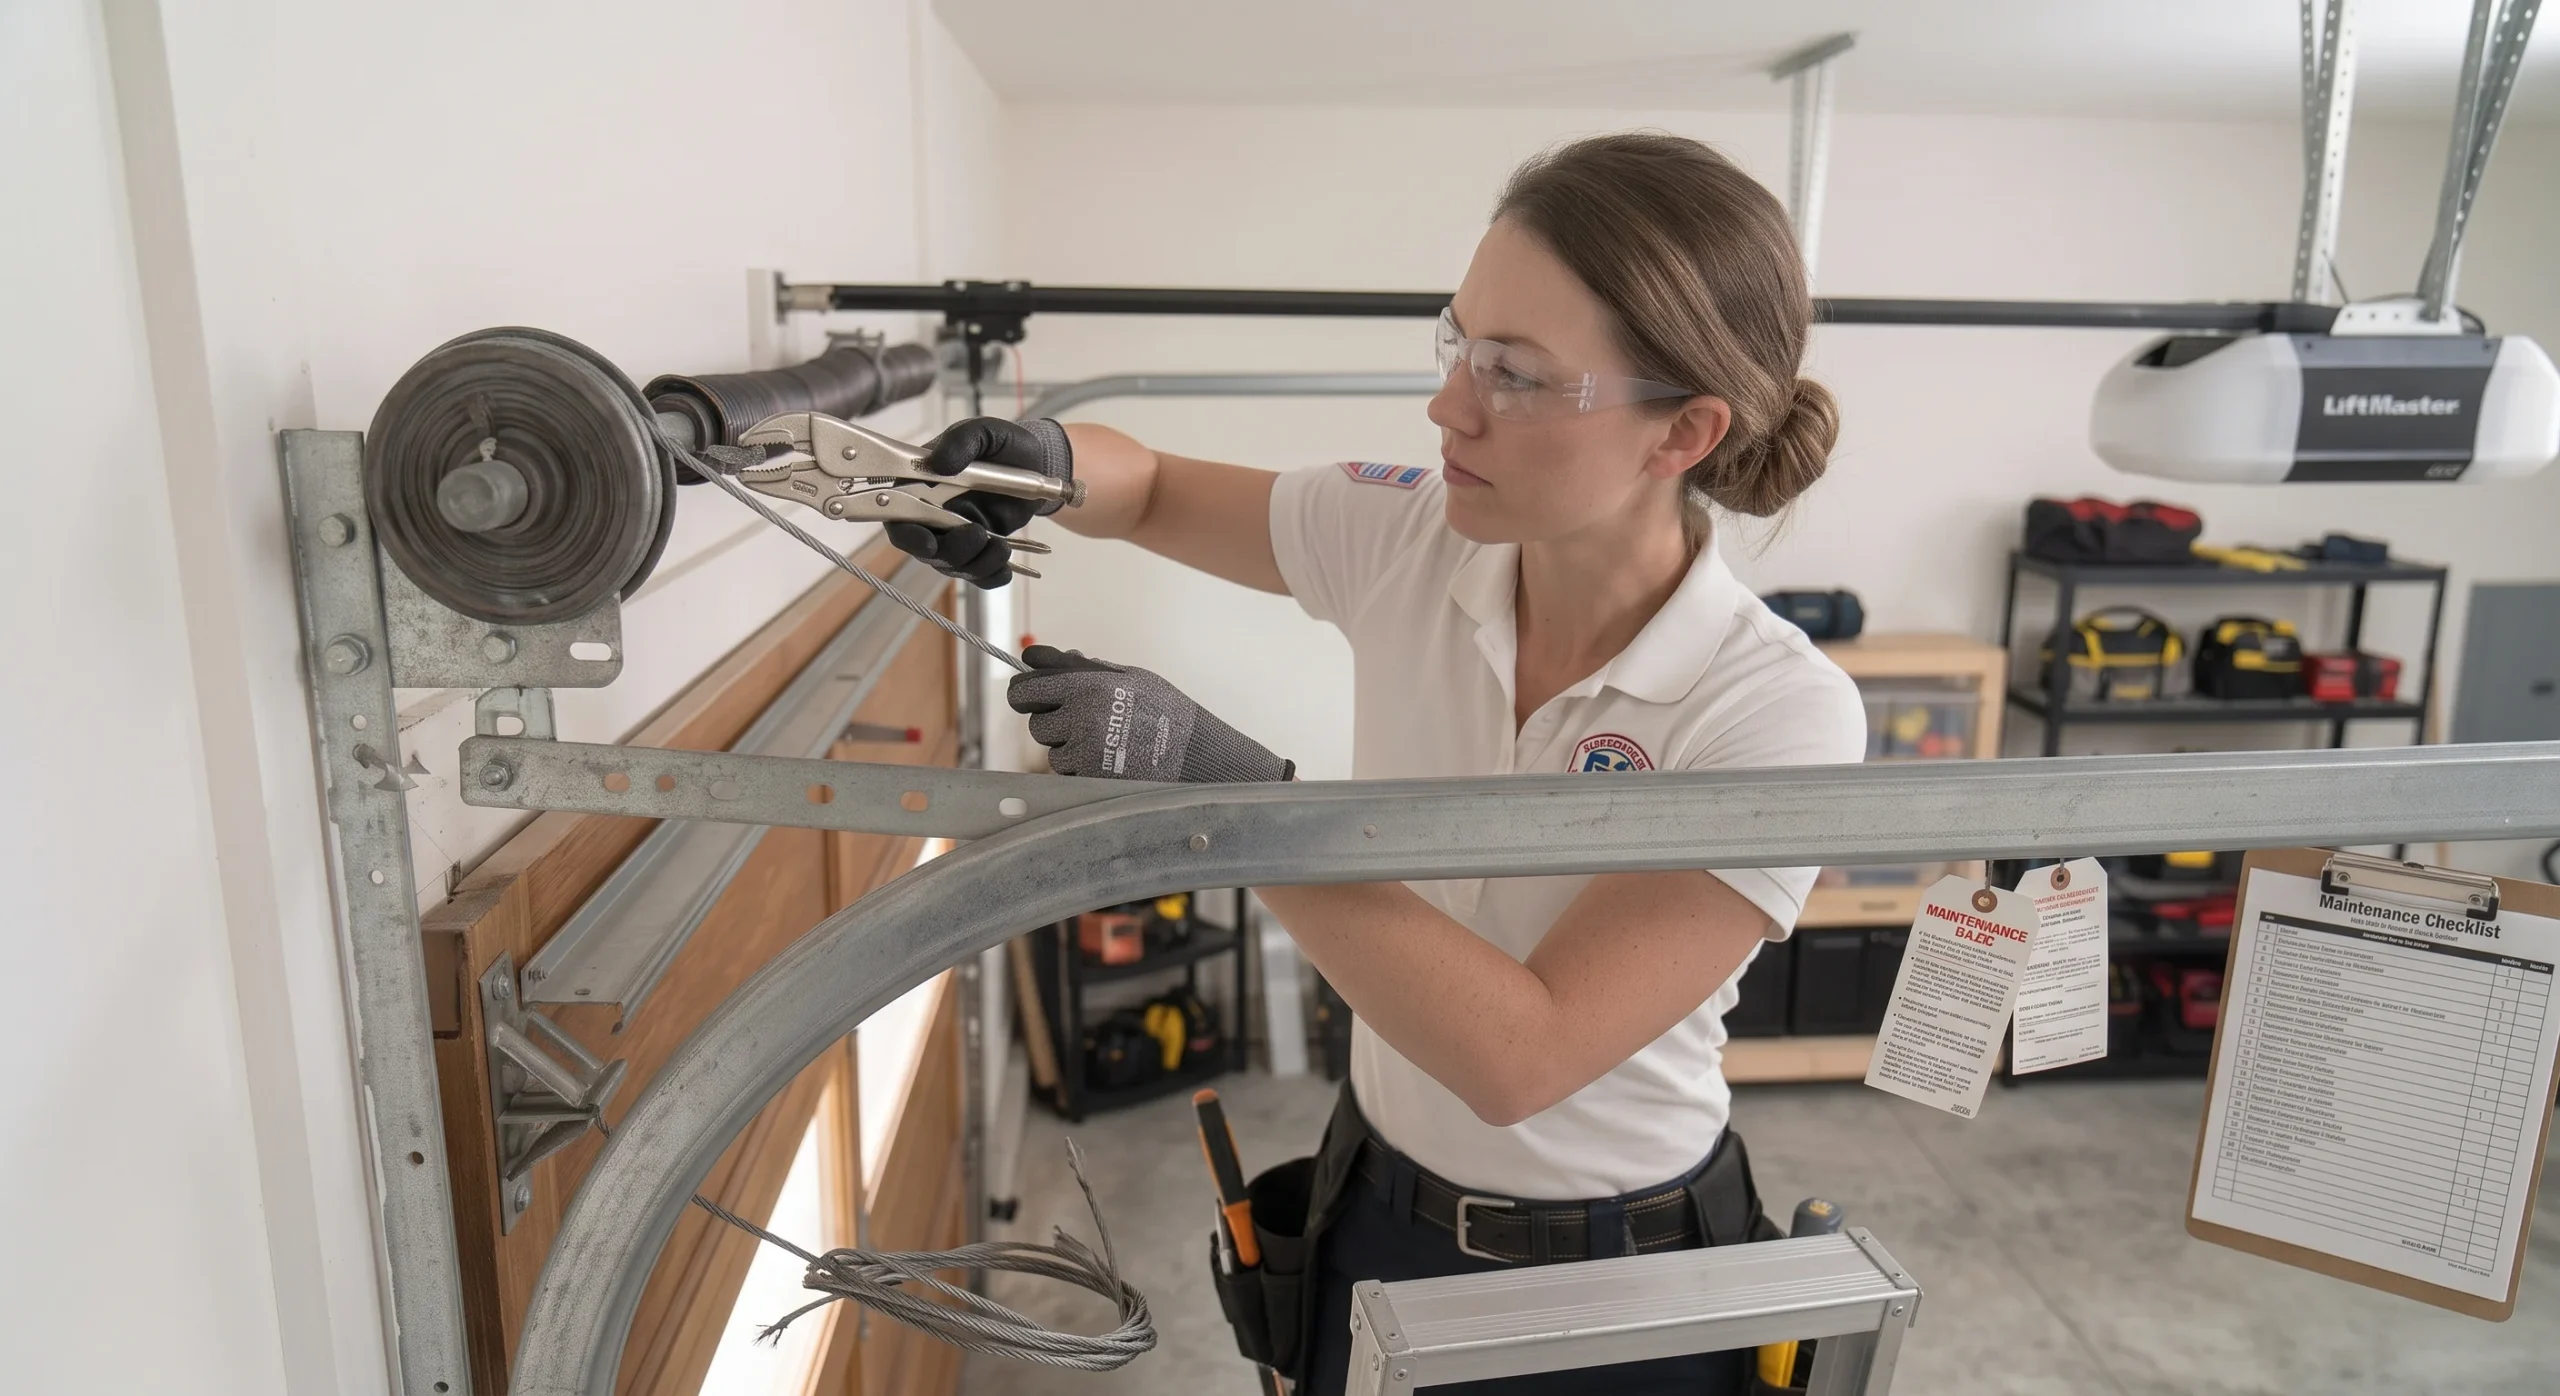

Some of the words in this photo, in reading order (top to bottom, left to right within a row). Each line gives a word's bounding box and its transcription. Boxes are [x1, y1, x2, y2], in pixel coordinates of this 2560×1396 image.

[2323, 394, 2460, 416] LiftMaster
[2319, 894, 2420, 925] Maintenance
[2425, 912, 2501, 940] Checklist
